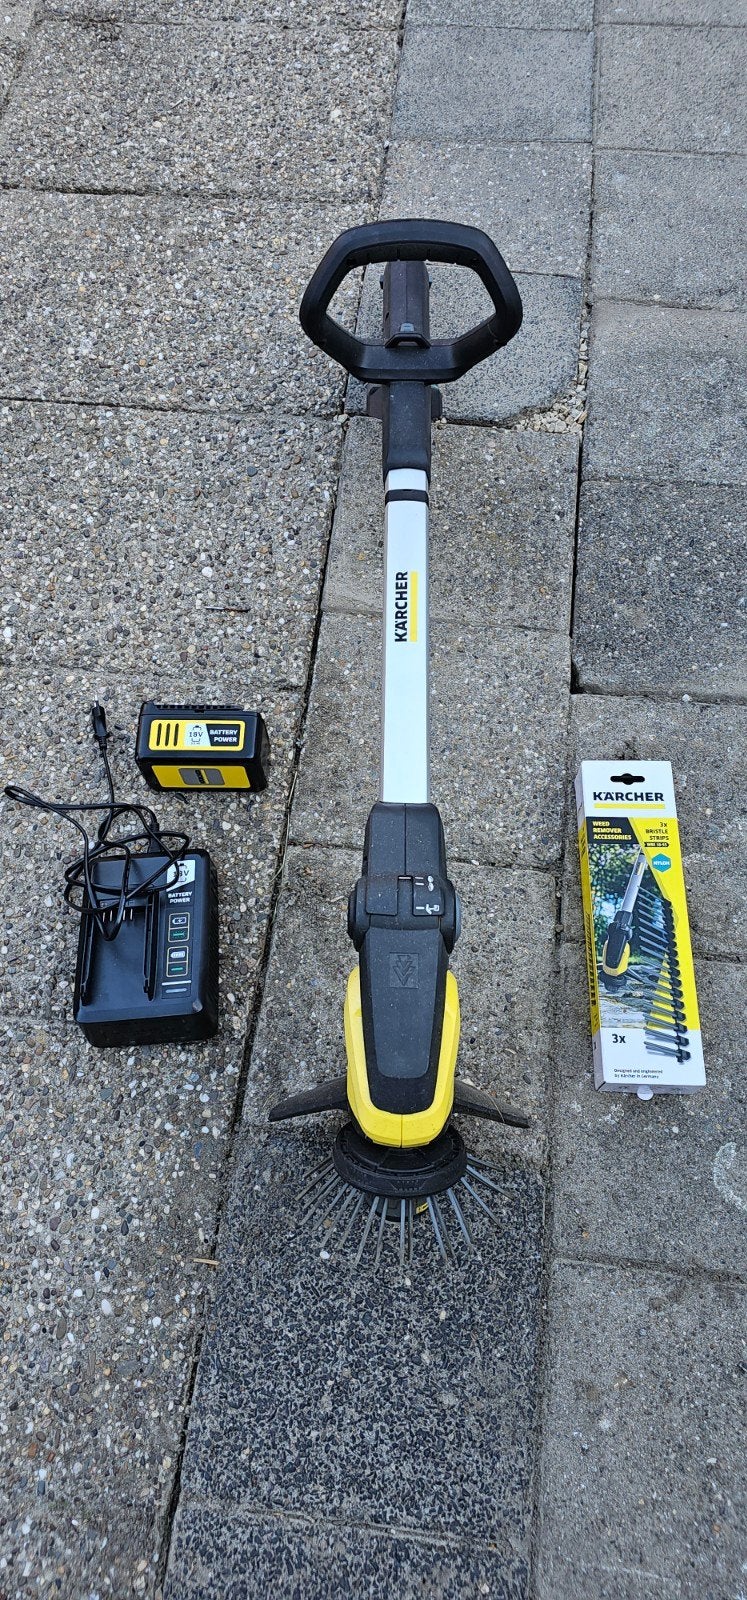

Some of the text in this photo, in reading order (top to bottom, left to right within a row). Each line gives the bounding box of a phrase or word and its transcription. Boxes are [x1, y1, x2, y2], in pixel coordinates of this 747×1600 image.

[394, 571, 408, 642] KÄRCHER
[593, 792, 664, 801] KÄRCHER
[612, 1034, 626, 1043] 3x
